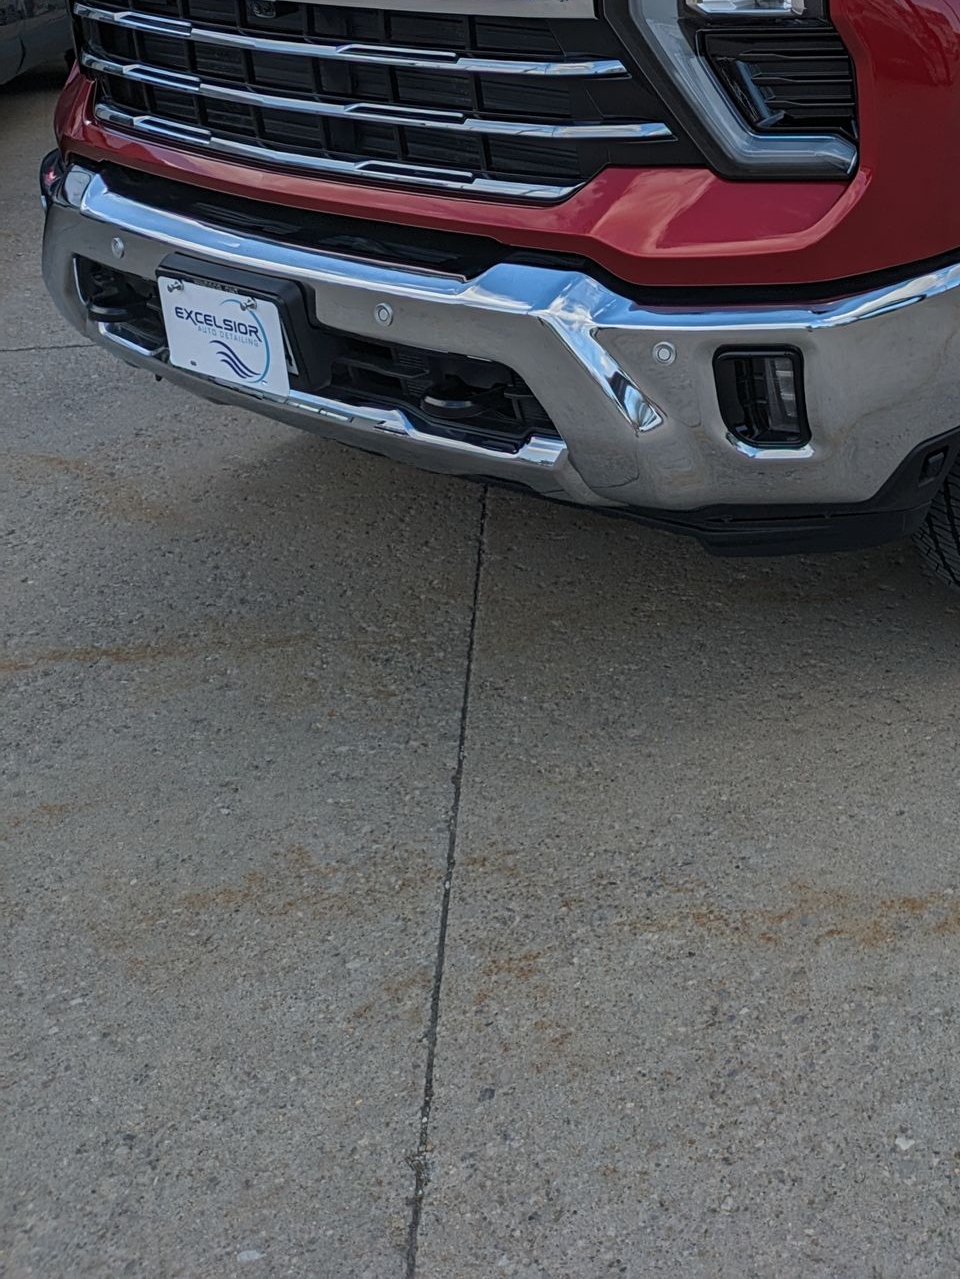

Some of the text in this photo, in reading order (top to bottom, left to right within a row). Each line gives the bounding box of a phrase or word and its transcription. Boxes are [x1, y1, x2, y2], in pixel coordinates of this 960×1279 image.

[174, 306, 263, 343] EXCELSIOR
[198, 325, 260, 347] AUTO DETAILING
